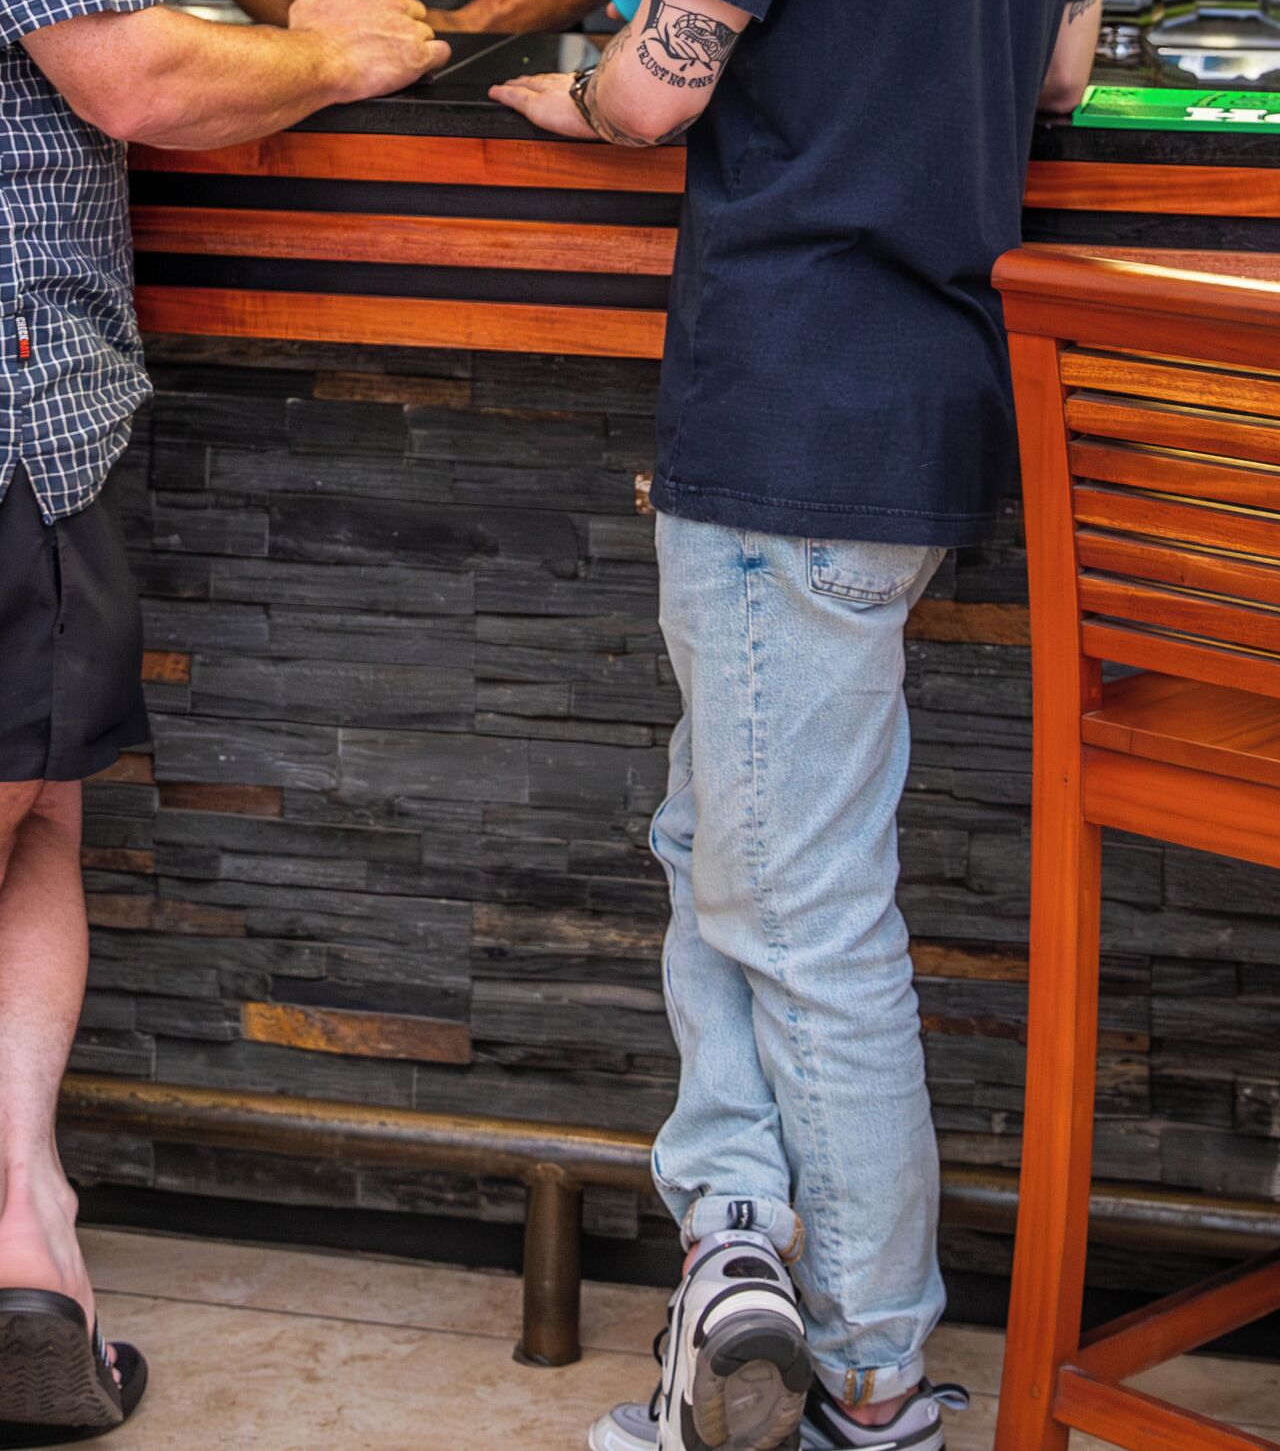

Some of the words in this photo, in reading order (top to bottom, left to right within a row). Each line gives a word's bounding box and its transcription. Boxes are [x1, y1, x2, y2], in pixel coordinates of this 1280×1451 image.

[637, 41, 668, 81] TRUST
[670, 73, 685, 88] NO
[688, 73, 714, 89] ONE
